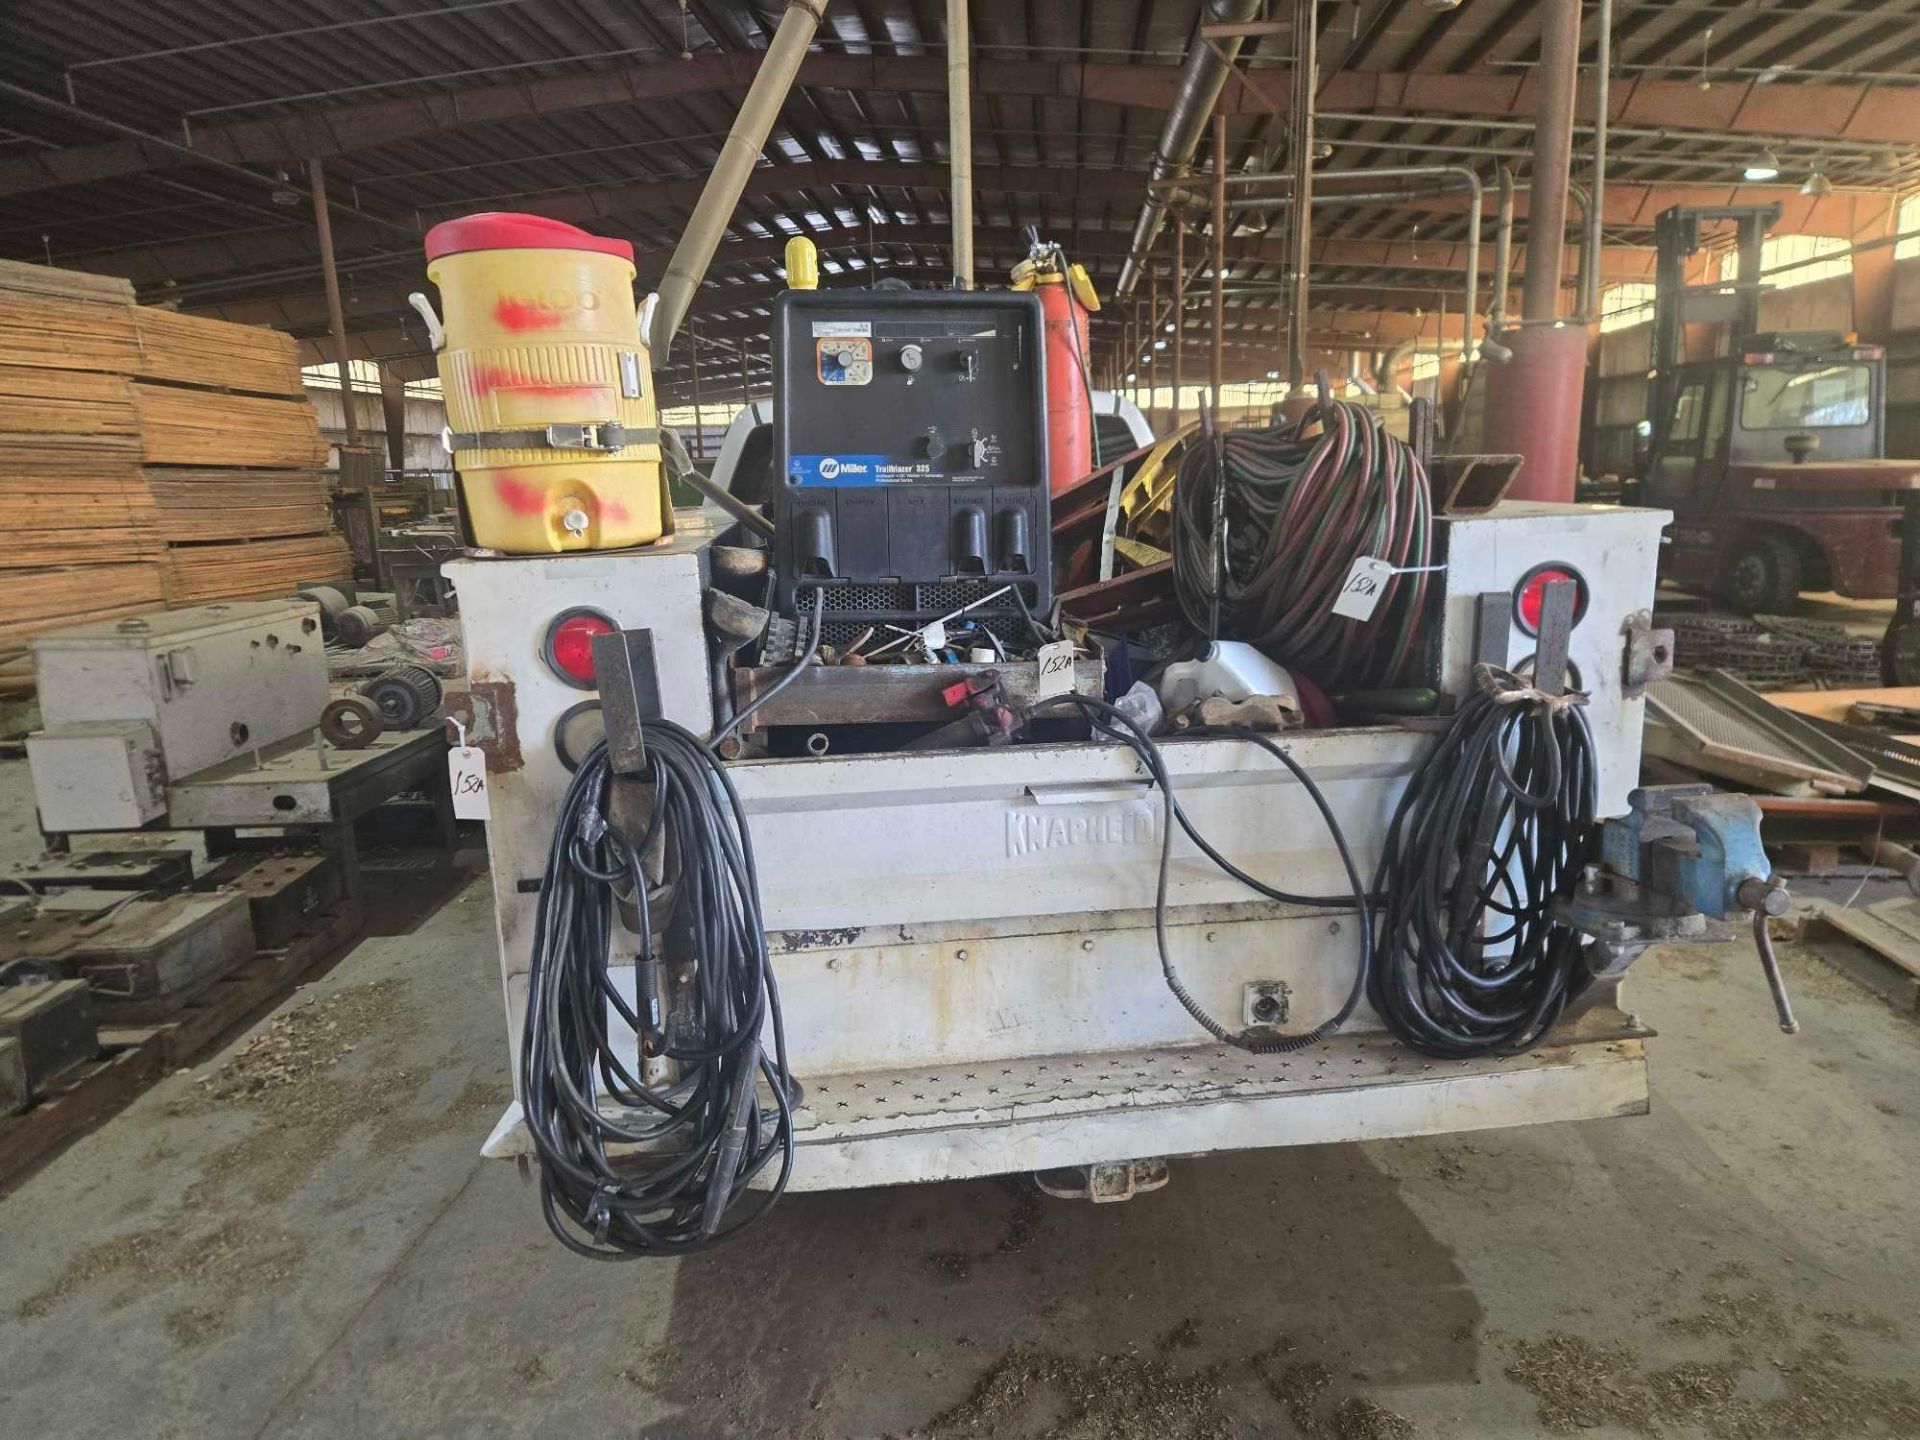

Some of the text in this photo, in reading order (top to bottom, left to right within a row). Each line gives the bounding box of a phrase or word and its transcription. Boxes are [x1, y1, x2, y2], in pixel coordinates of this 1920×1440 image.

[841, 463, 868, 473] Miller
[875, 464, 930, 473] Trailblazer 325
[1342, 572, 1378, 597] 152A
[1041, 655, 1073, 676] 152A
[454, 770, 485, 796] 152A
